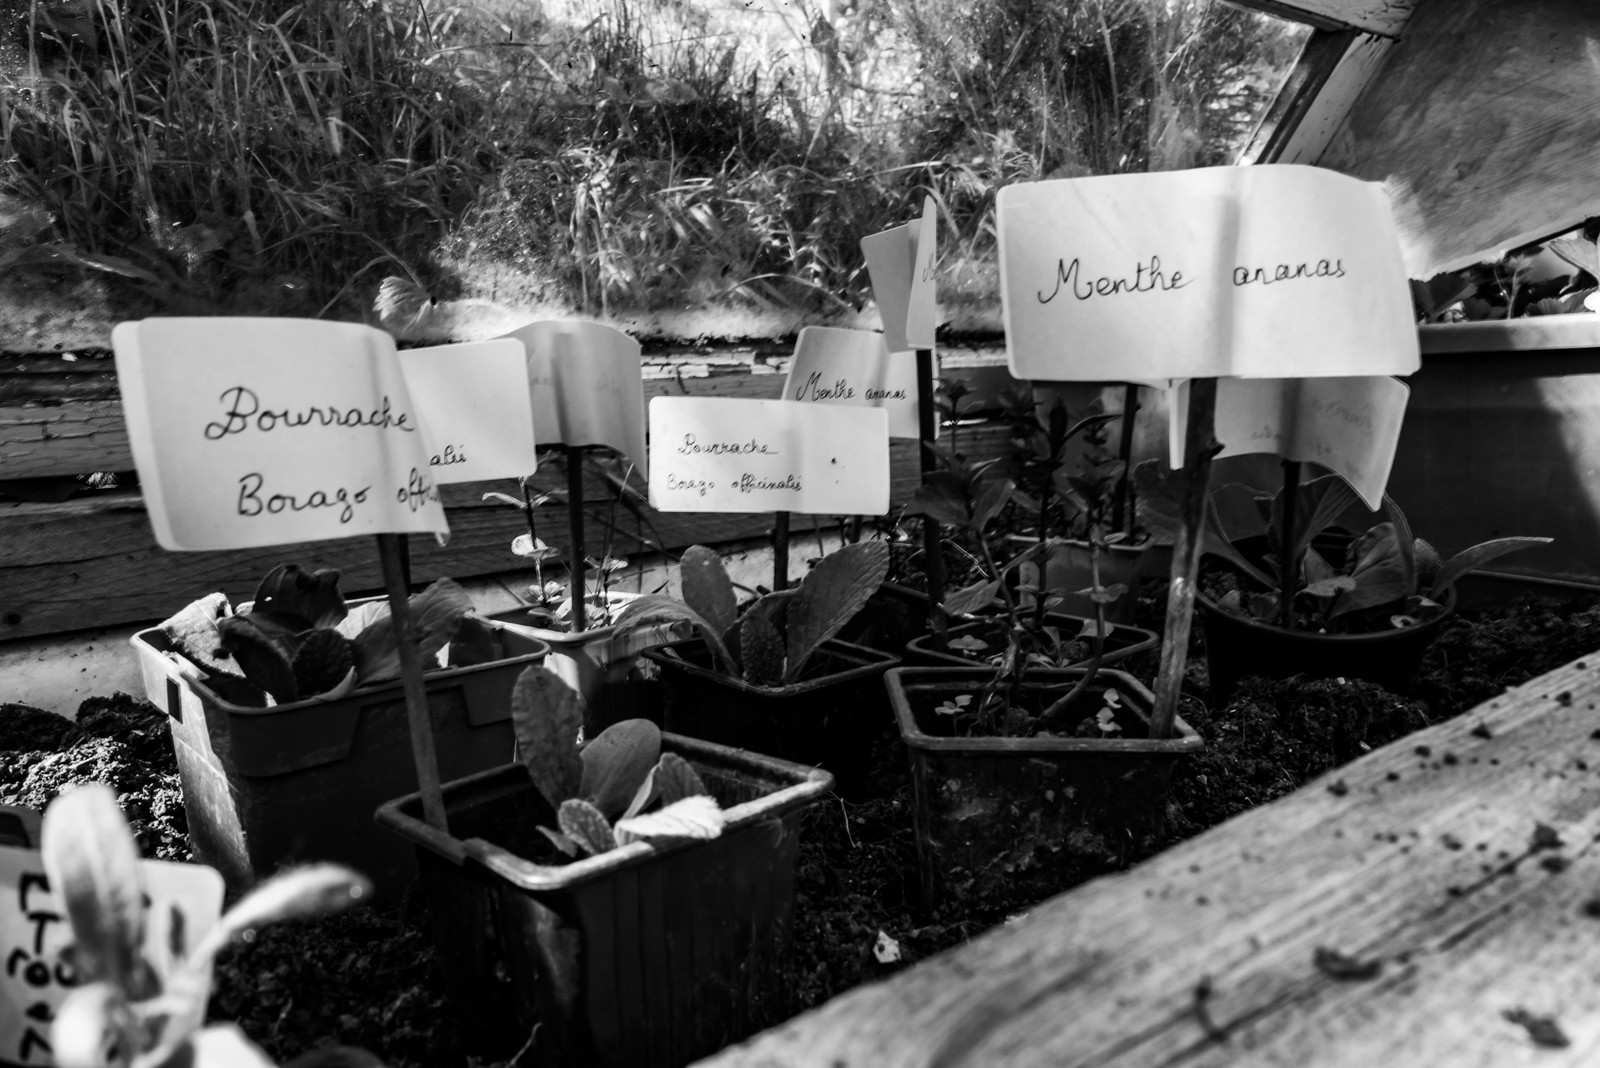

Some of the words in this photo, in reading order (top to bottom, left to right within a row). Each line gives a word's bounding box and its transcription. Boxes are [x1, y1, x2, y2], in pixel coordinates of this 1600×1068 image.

[1037, 255, 1193, 304] Menthe
[1233, 258, 1347, 286] ananas
[796, 371, 856, 401] Menthe
[865, 386, 906, 401] ananas
[204, 386, 415, 440] Bourrache
[678, 433, 779, 455] Bourrache
[237, 472, 371, 523] Borago
[668, 473, 715, 496] Borago
[731, 472, 802, 495] officinalis
